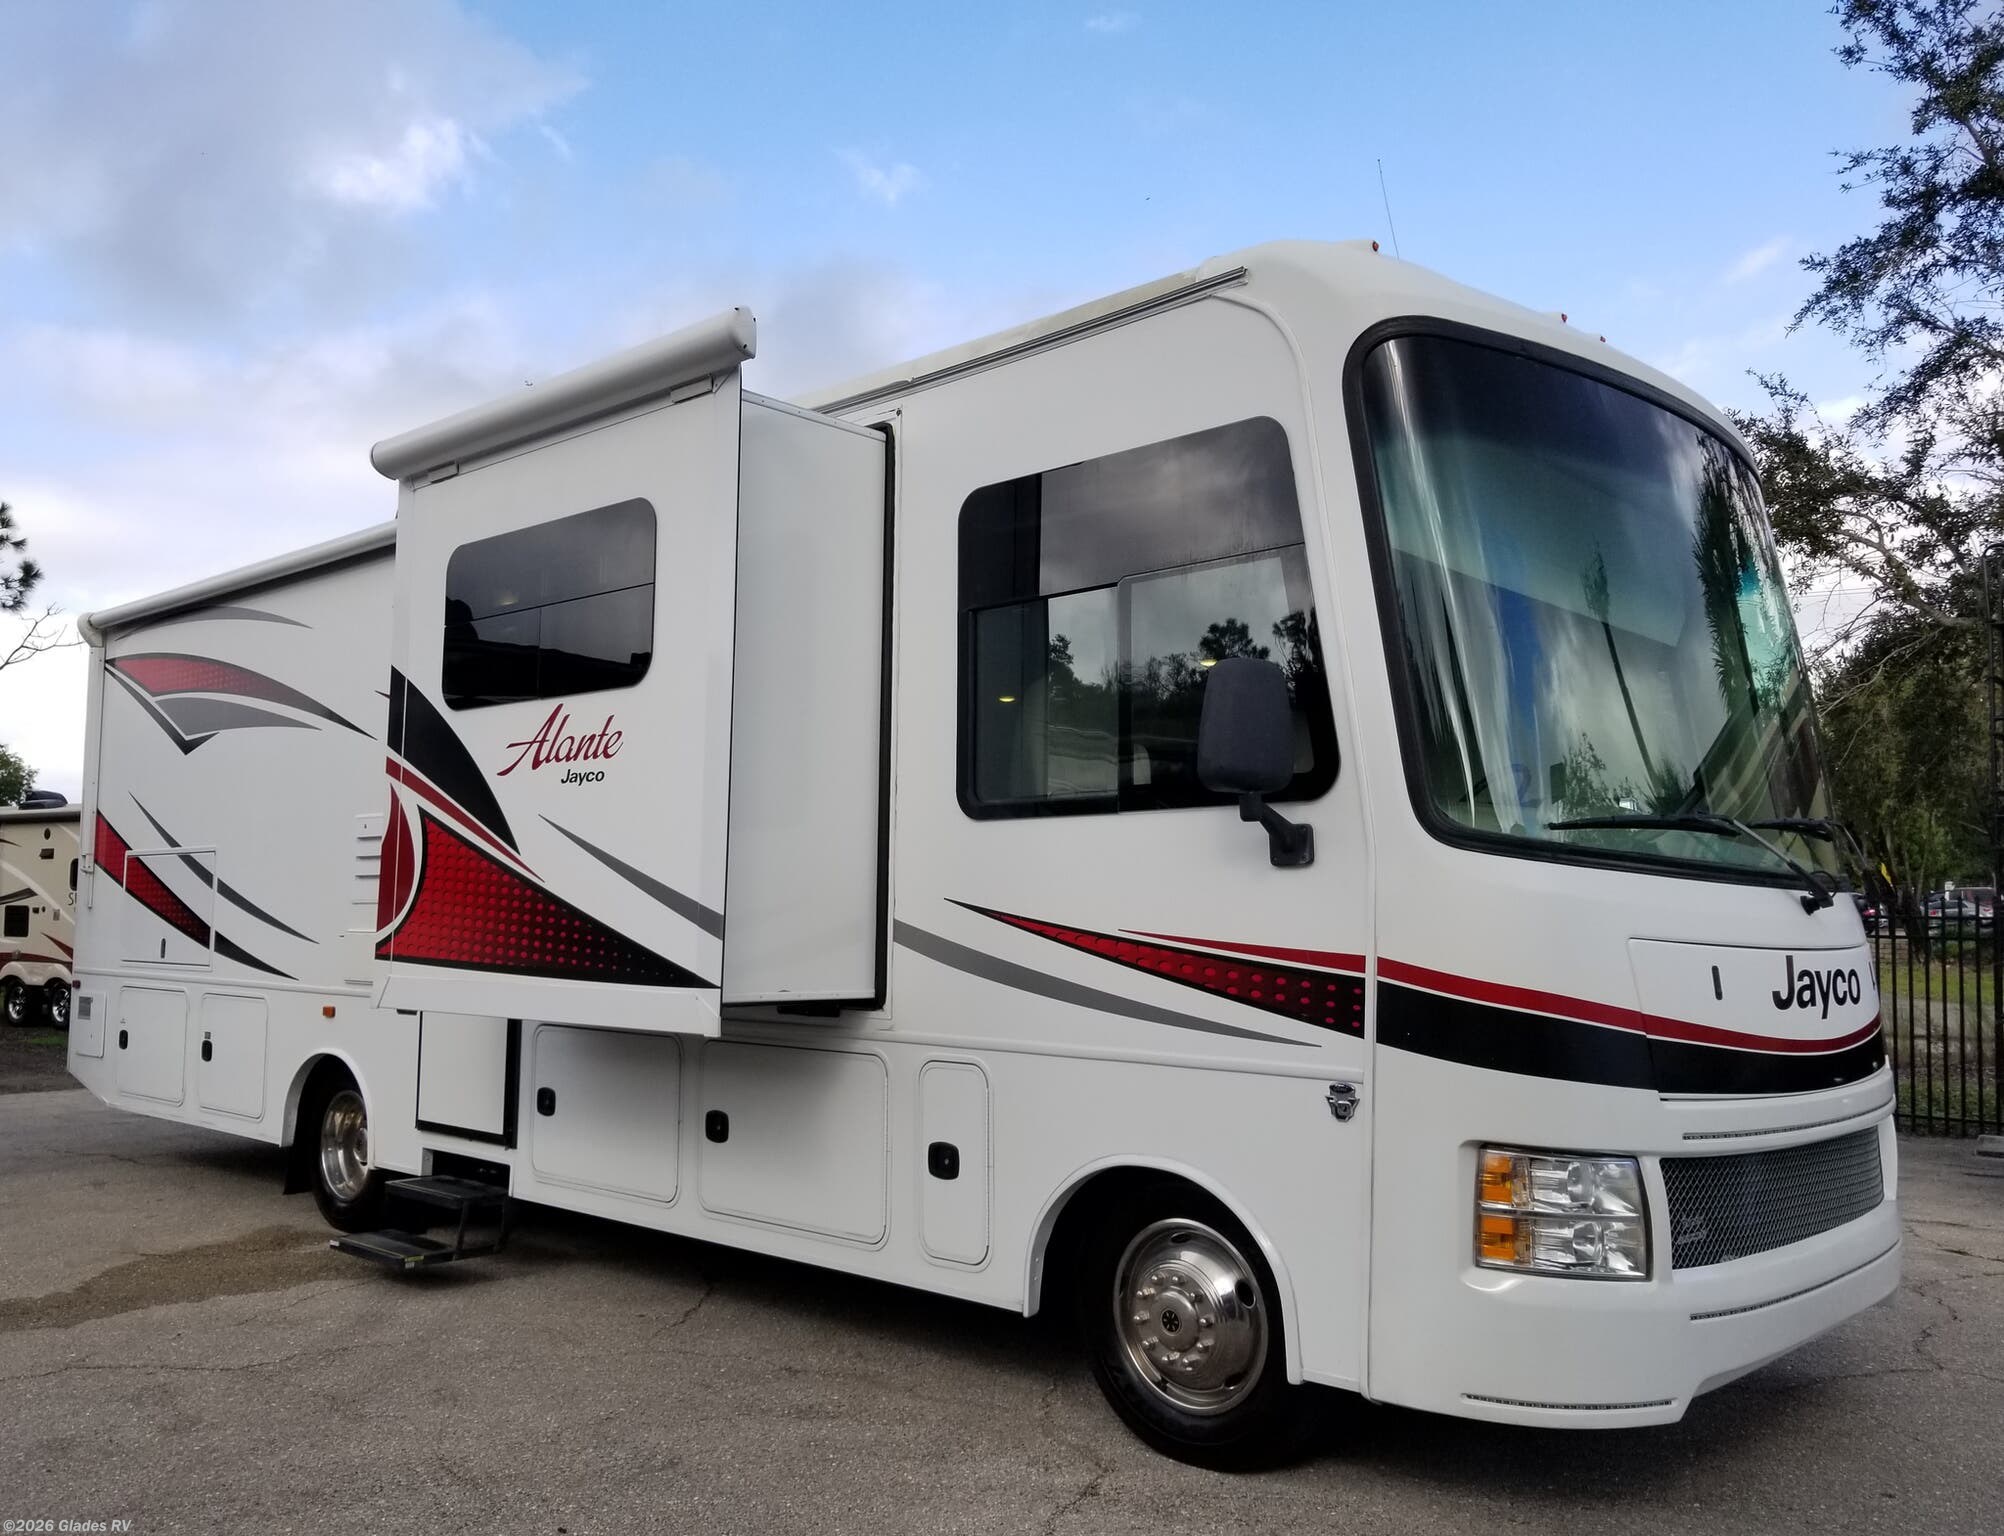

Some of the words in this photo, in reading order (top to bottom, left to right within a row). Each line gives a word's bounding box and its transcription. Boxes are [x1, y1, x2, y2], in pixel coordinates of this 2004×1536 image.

[497, 703, 623, 777] Alante
[560, 768, 605, 787] Jayco
[1771, 955, 1861, 1020] Jayco
